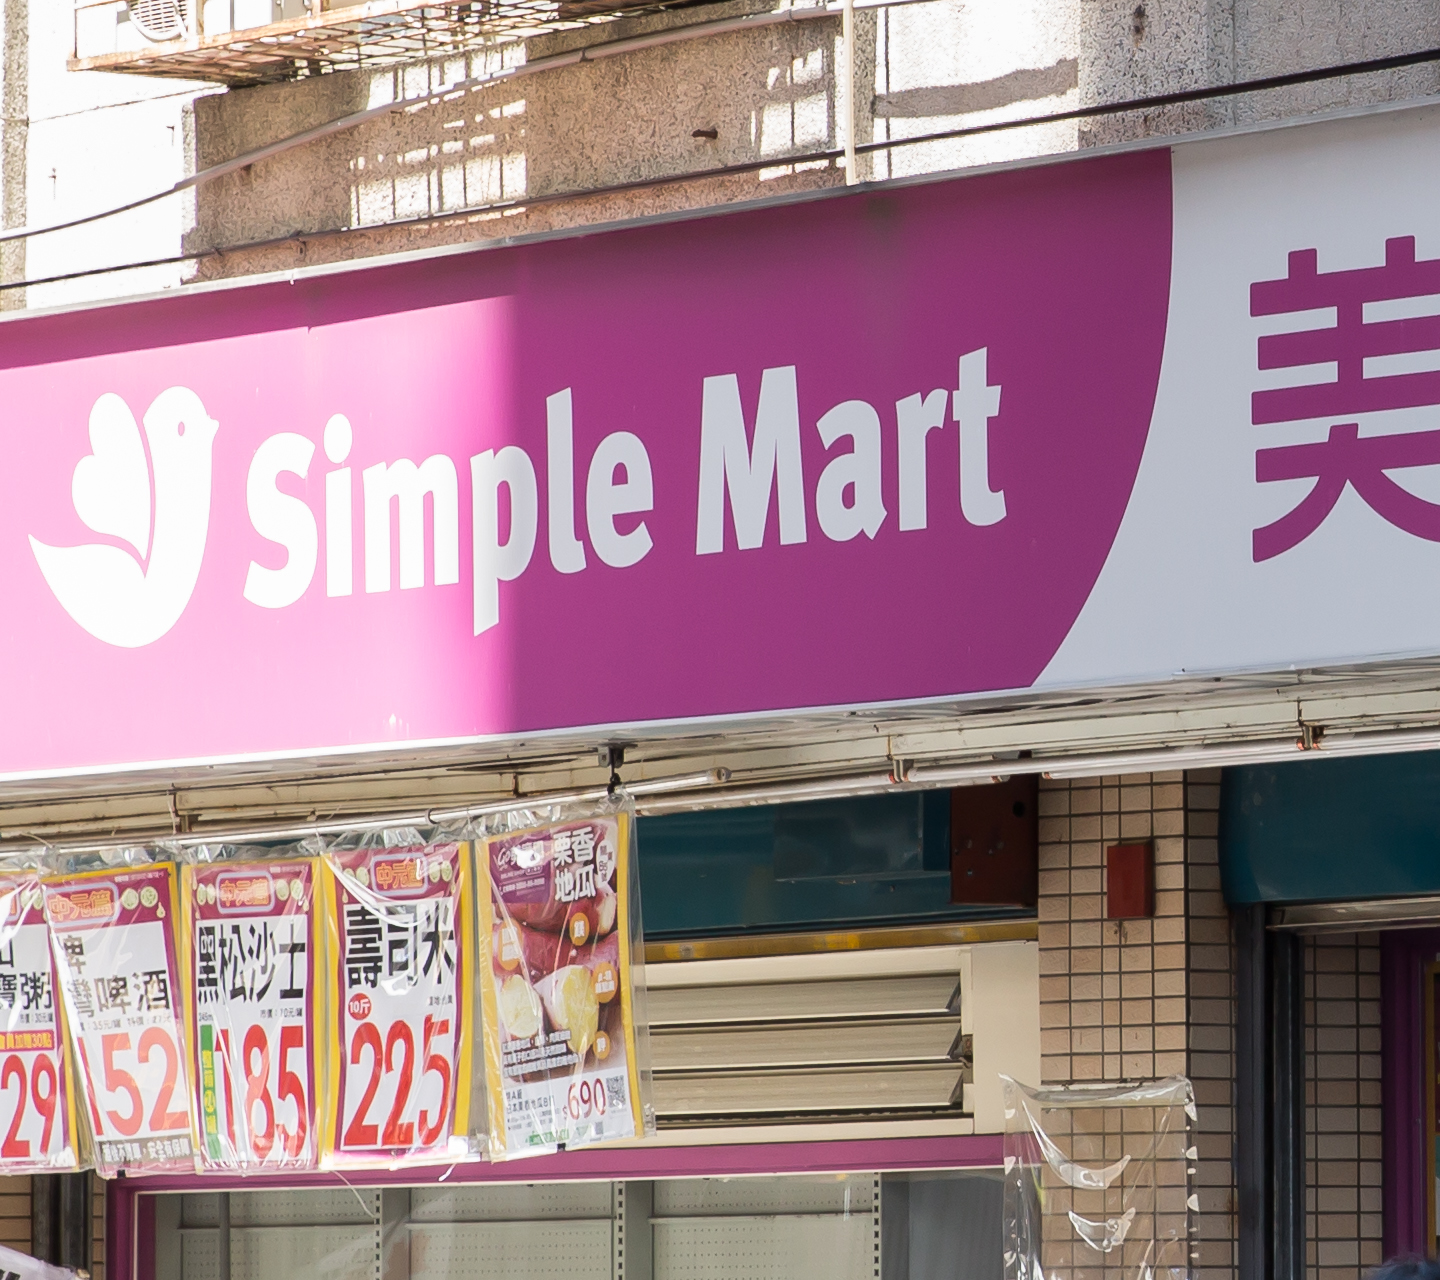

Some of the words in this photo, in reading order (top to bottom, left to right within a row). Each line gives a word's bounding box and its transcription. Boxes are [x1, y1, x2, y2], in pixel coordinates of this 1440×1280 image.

[243, 387, 655, 637] Simple
[696, 347, 1006, 557] Mart
[553, 826, 596, 867] 栗香
[554, 863, 596, 903] 地瓜
[198, 922, 306, 1003] 黑松沙士
[345, 901, 455, 989] 壽司米
[214, 1024, 307, 1158] 185
[343, 1013, 452, 1147] 225
